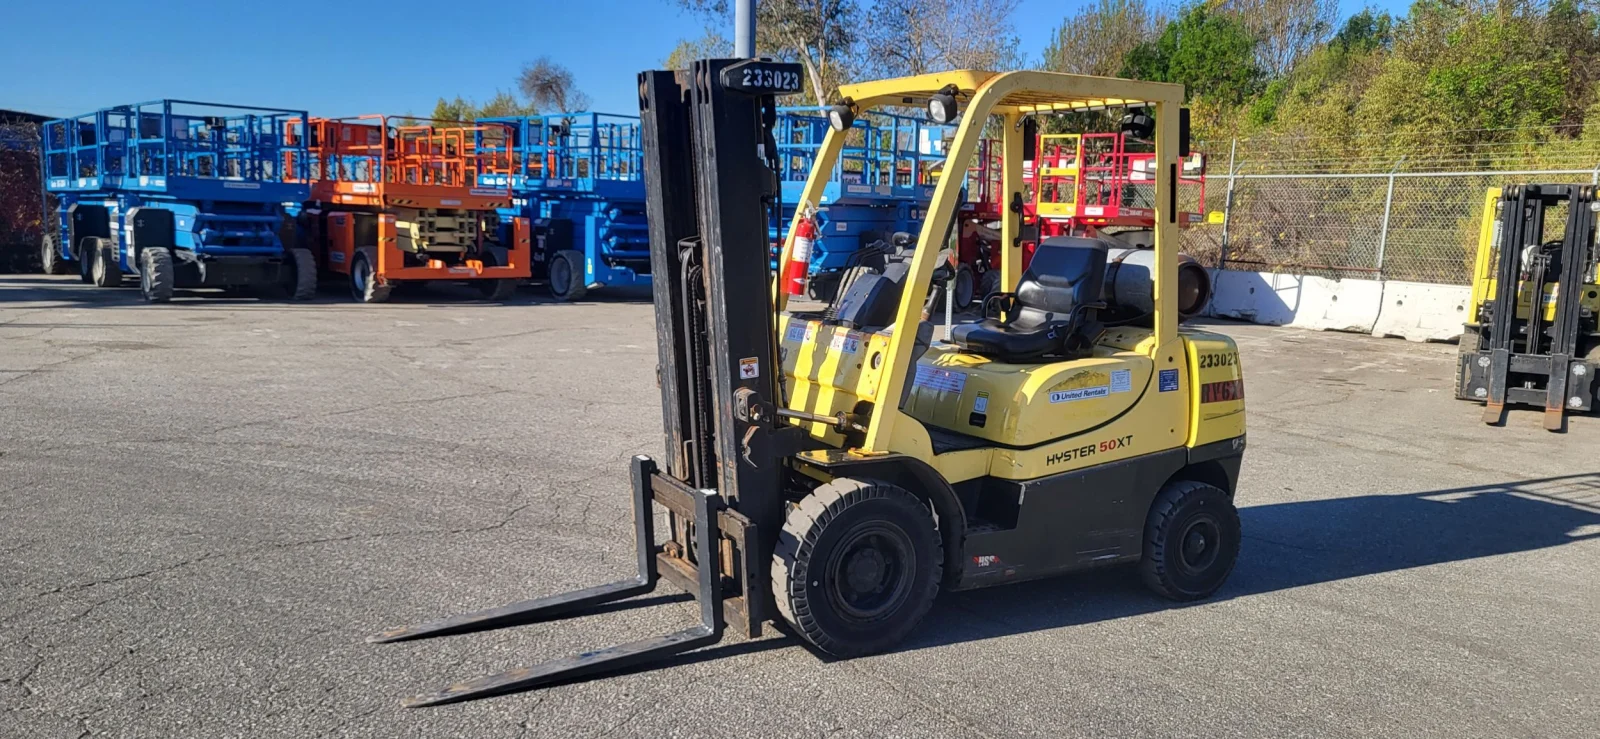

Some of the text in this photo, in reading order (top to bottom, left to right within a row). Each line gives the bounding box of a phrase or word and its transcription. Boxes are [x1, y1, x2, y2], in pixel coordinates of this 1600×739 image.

[742, 68, 799, 90] 233023
[1200, 352, 1239, 368] 233023
[1061, 388, 1107, 400] United Rentals
[1046, 444, 1096, 466] HYSTER
